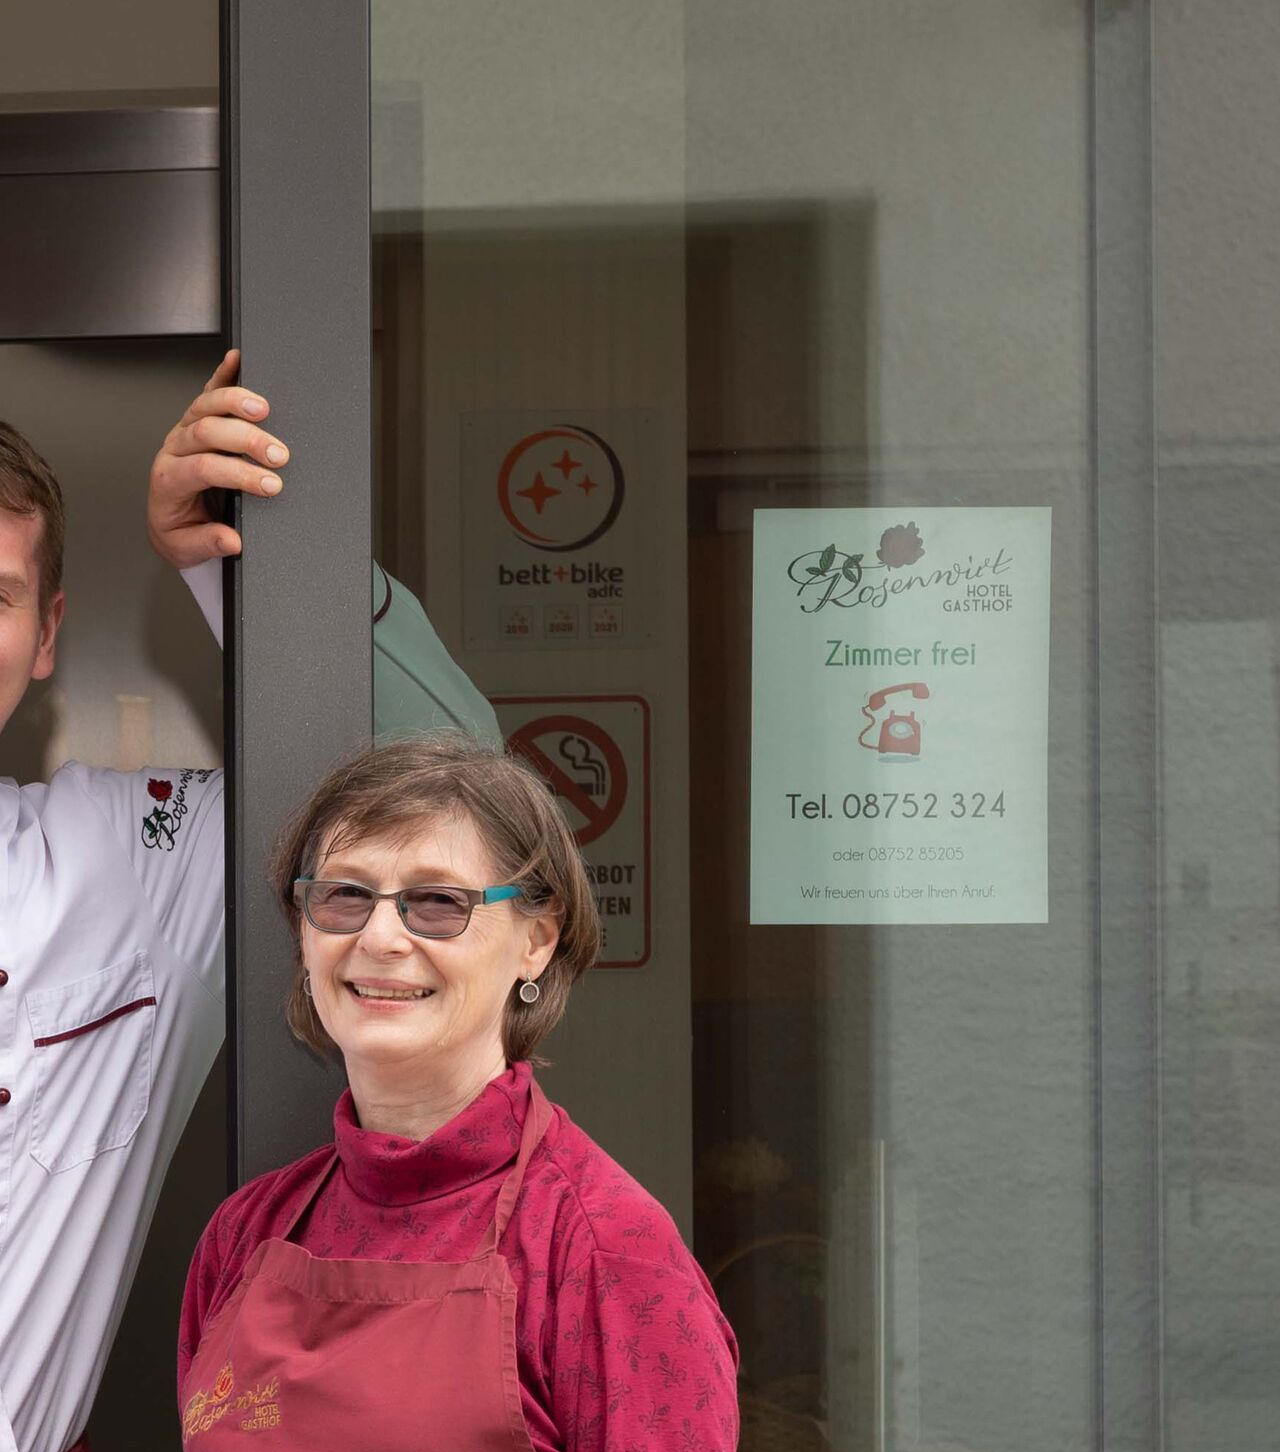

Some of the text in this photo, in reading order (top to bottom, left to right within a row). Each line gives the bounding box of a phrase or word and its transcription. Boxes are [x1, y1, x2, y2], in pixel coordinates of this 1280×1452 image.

[498, 561, 625, 586] bett+bike
[967, 584, 1013, 598] HOTEL
[942, 599, 1014, 613] GASTHOF
[824, 640, 977, 667] Zimmer frei
[785, 790, 1006, 820] Tel. 08752 324
[832, 846, 965, 862] oder 08752 85205
[800, 885, 821, 899] Wir
[824, 885, 865, 900] freuen
[867, 886, 889, 899] uns
[893, 884, 924, 899] über
[927, 884, 958, 899] Ihren
